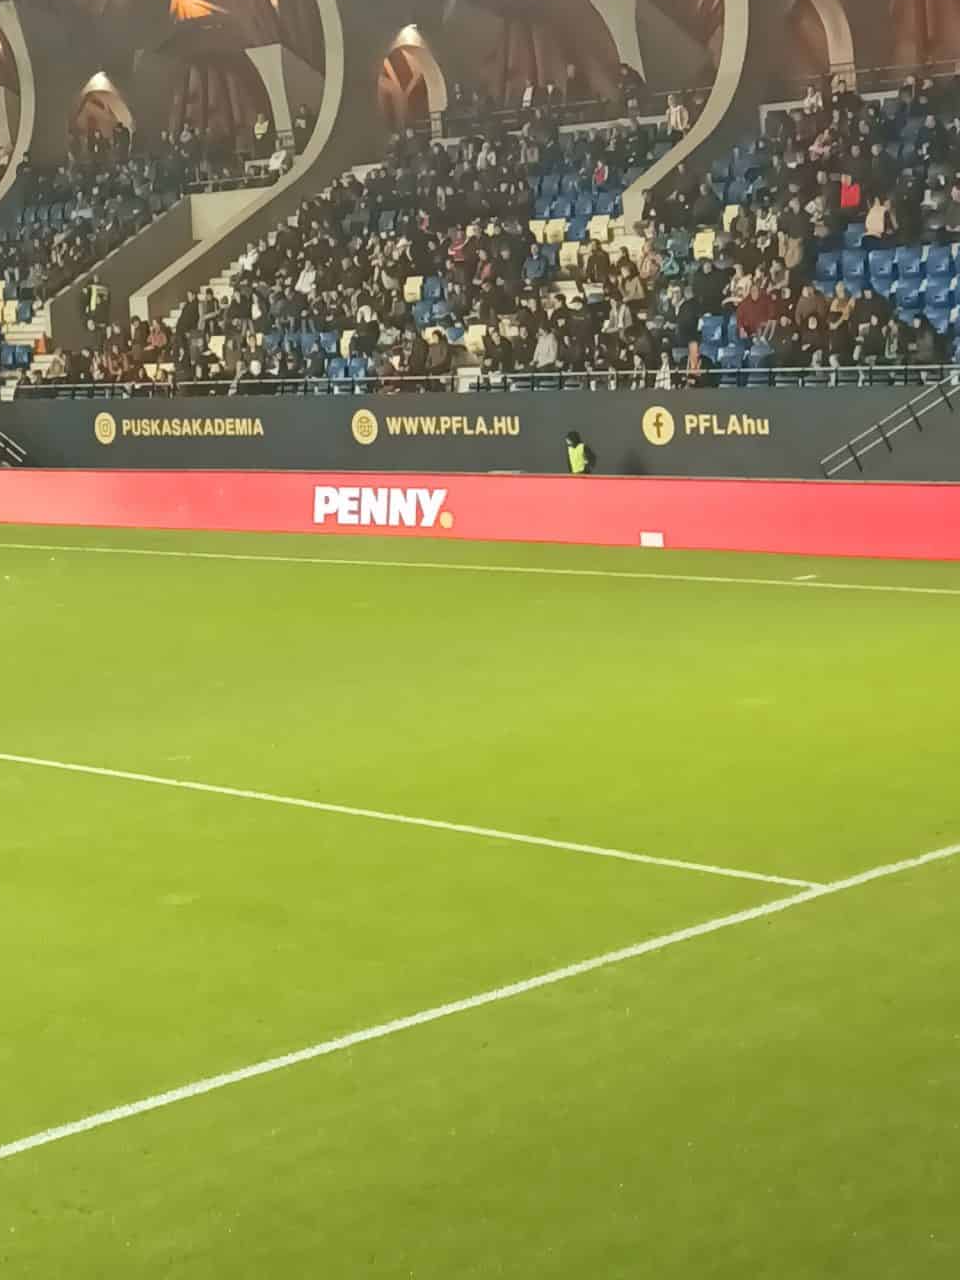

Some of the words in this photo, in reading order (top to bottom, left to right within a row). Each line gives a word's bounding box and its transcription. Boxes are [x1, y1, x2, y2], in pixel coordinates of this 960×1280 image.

[122, 418, 265, 437] PUSKASAKADEMIA
[386, 416, 520, 436] WWW.PFLA.HU
[684, 415, 770, 435] PFLAhu
